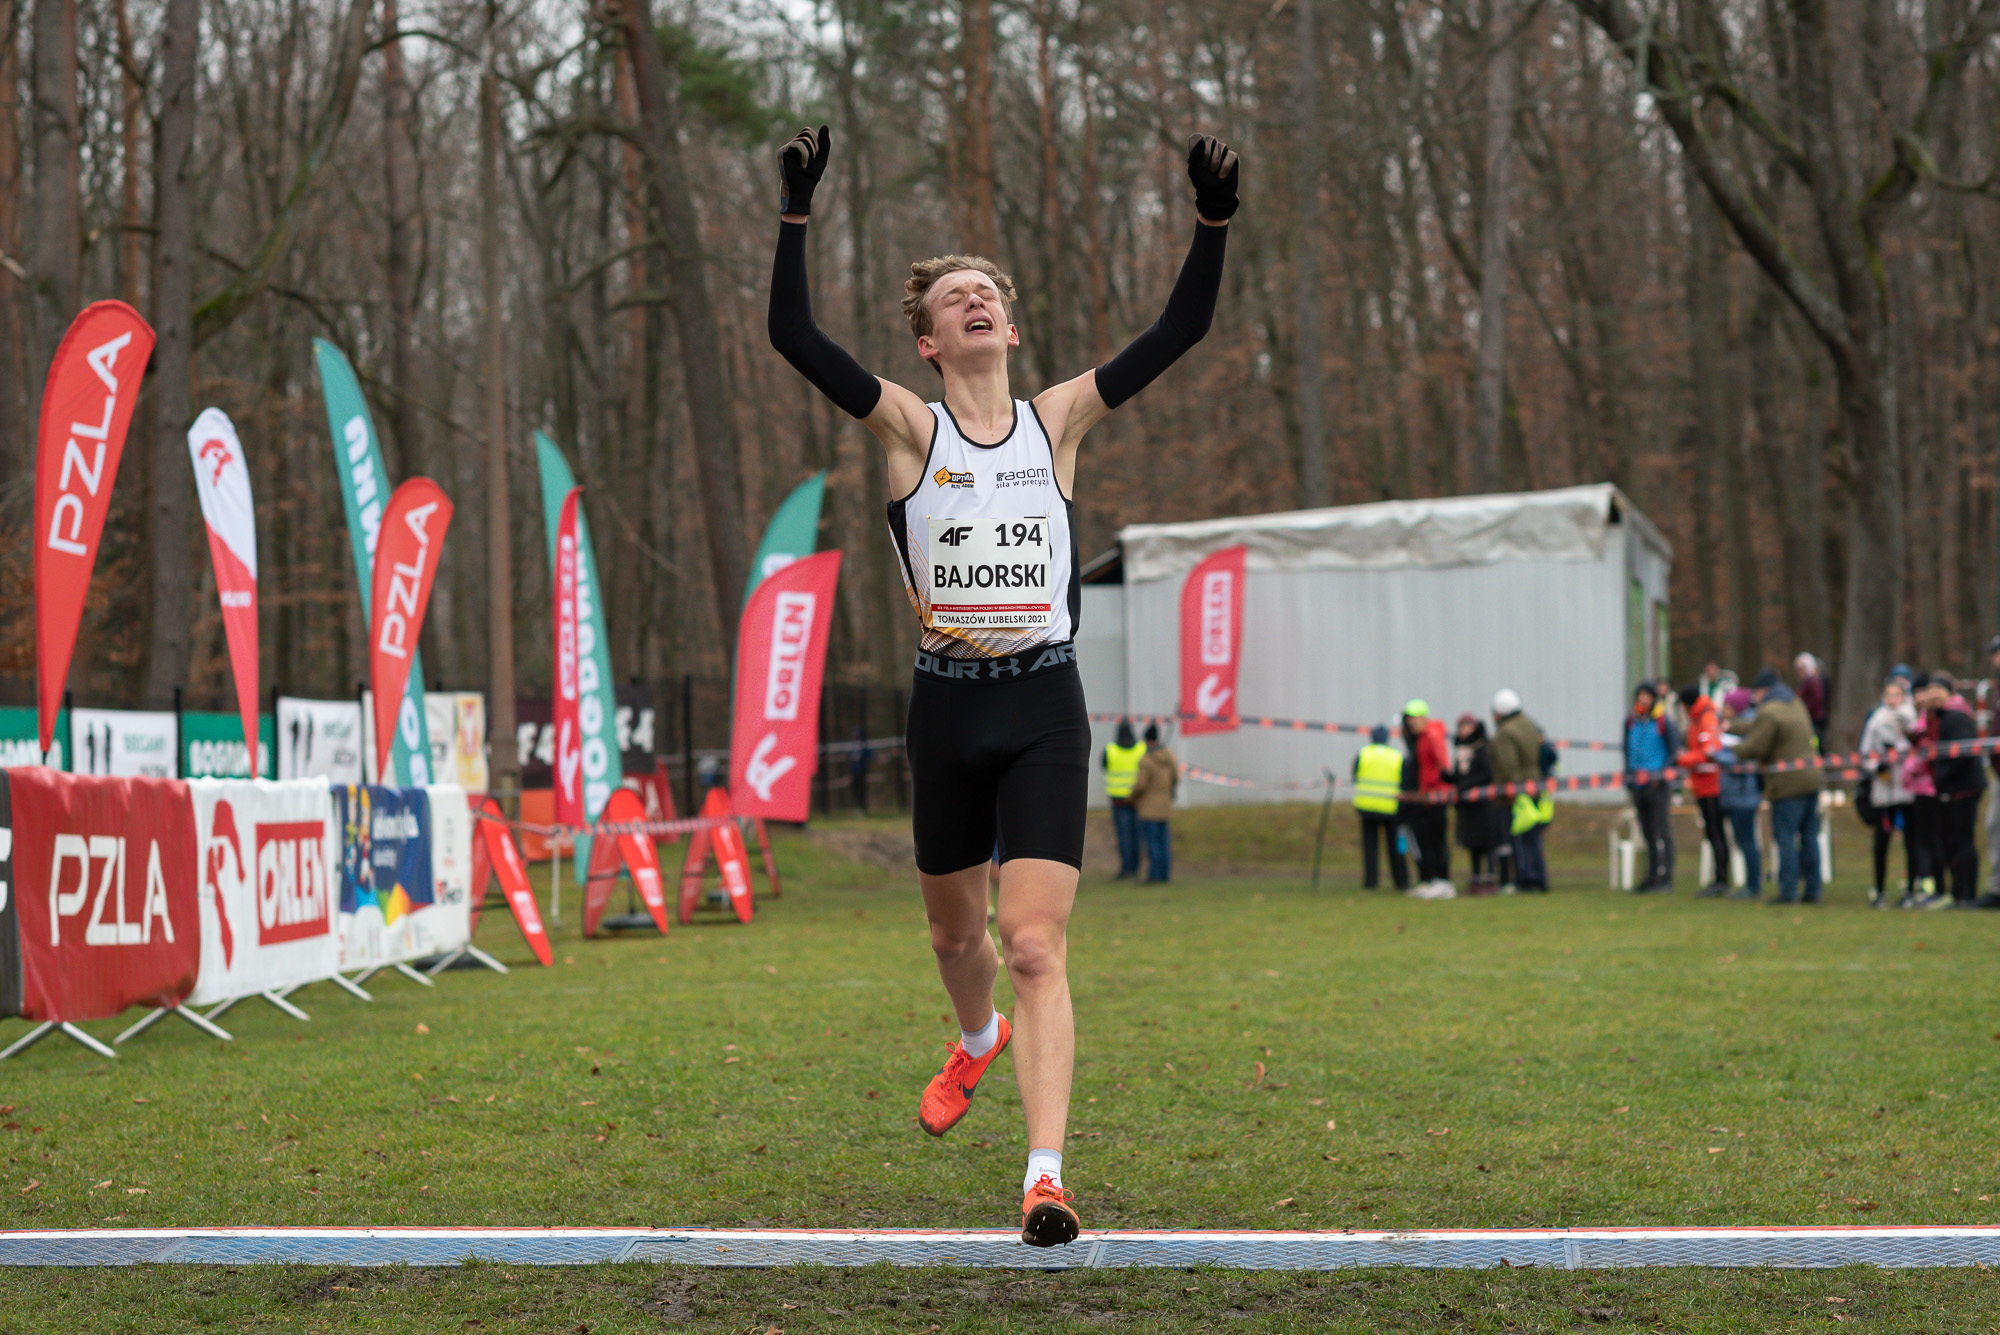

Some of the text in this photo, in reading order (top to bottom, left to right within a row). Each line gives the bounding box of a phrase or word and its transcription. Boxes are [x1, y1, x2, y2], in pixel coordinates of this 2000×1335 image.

[47, 331, 133, 557] PZLA
[951, 473, 974, 482] OPTMA
[996, 468, 1049, 482] radom
[939, 526, 974, 547] 4F
[995, 523, 1043, 547] 194
[378, 502, 439, 660] PZLA
[934, 563, 1046, 589] BAJORSKI
[937, 614, 1047, 624] TOMASZÓW LUBELSKI 2021
[771, 600, 808, 712] ORLEN
[49, 832, 176, 947] PZLA
[258, 835, 327, 931] ORLEN
